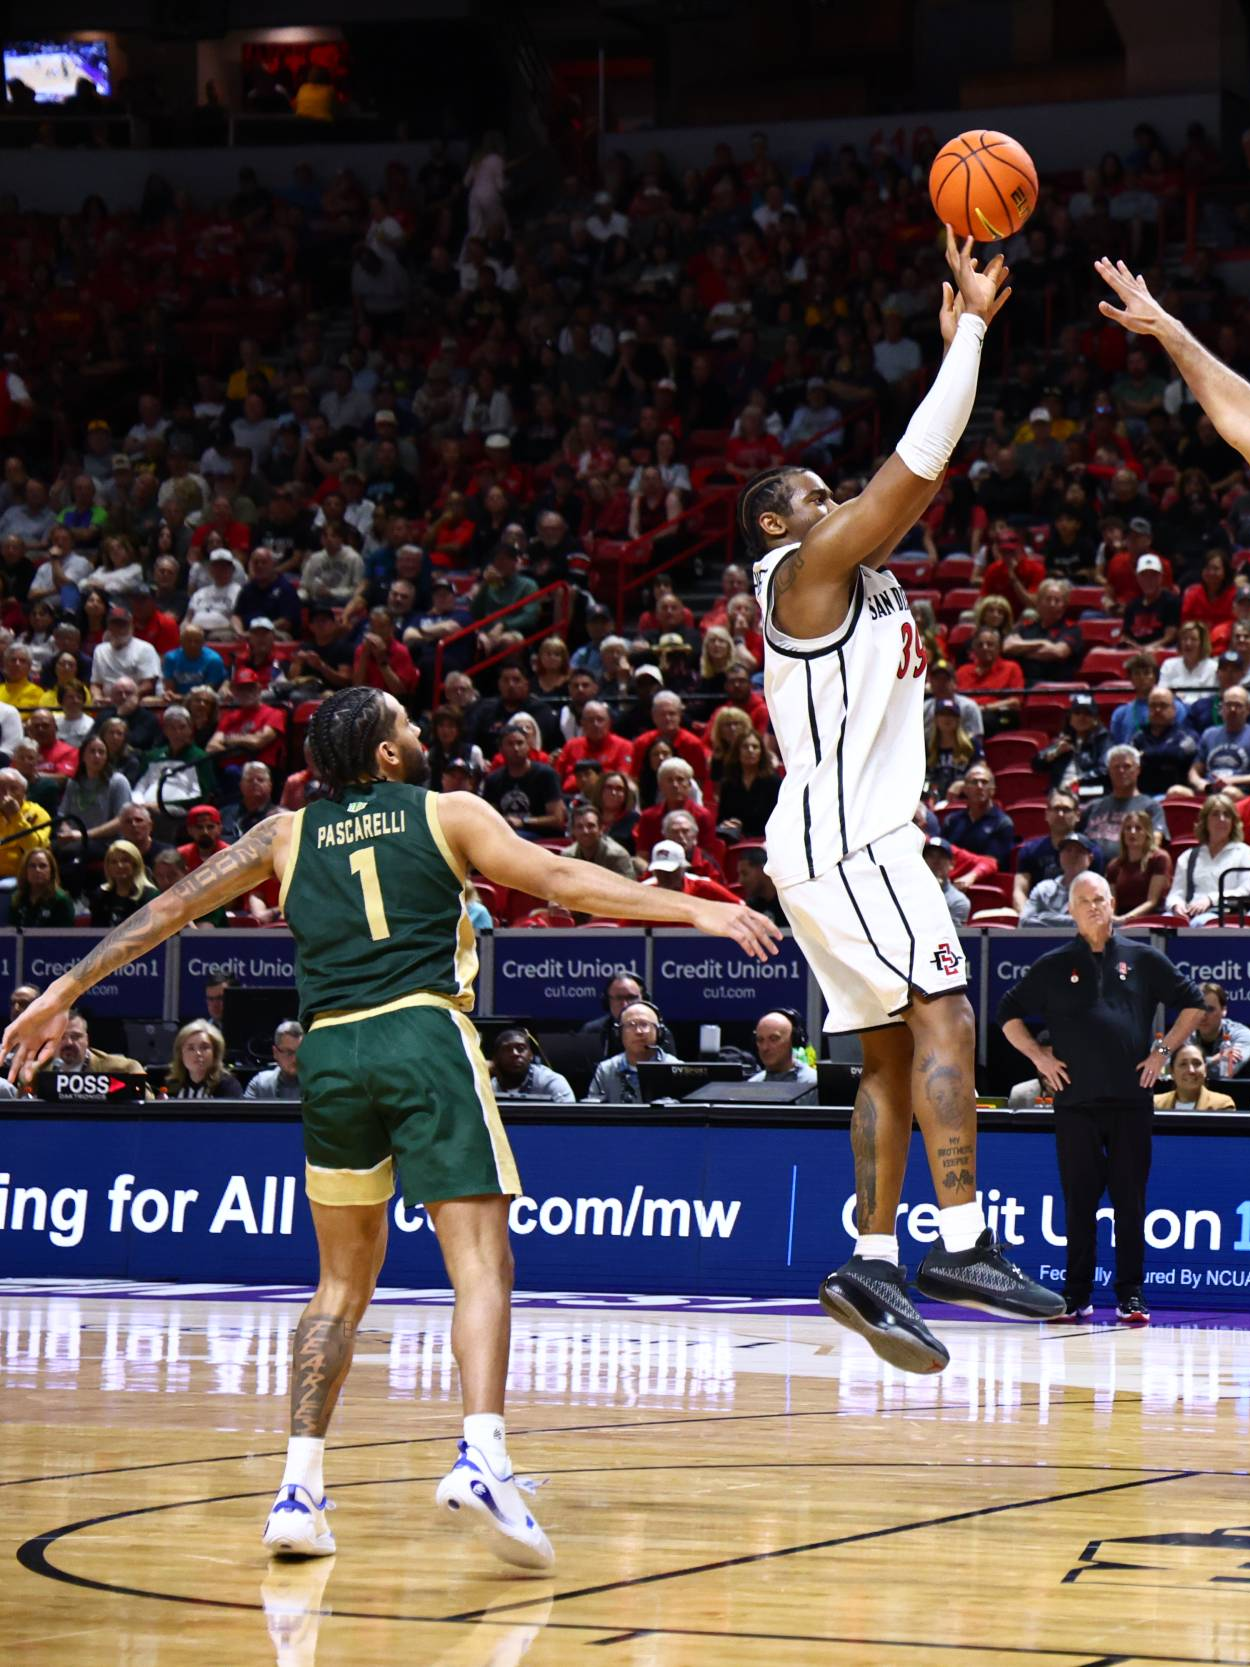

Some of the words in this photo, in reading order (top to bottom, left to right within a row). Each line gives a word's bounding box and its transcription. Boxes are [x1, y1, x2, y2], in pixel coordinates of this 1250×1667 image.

[867, 590, 896, 620] SAN
[317, 809, 405, 849] PASCARELLI
[348, 846, 391, 942] 1
[250, 958, 295, 978] Unio
[502, 958, 563, 978] Credit
[661, 959, 723, 979] Credit
[727, 960, 788, 979] Union
[790, 961, 800, 979] 1
[544, 985, 597, 999] cu1.com
[703, 985, 756, 999] cu1.com
[56, 1074, 110, 1094] POSS
[108, 1174, 199, 1233] for
[209, 1176, 296, 1234] All
[1180, 1269, 1202, 1289] By
